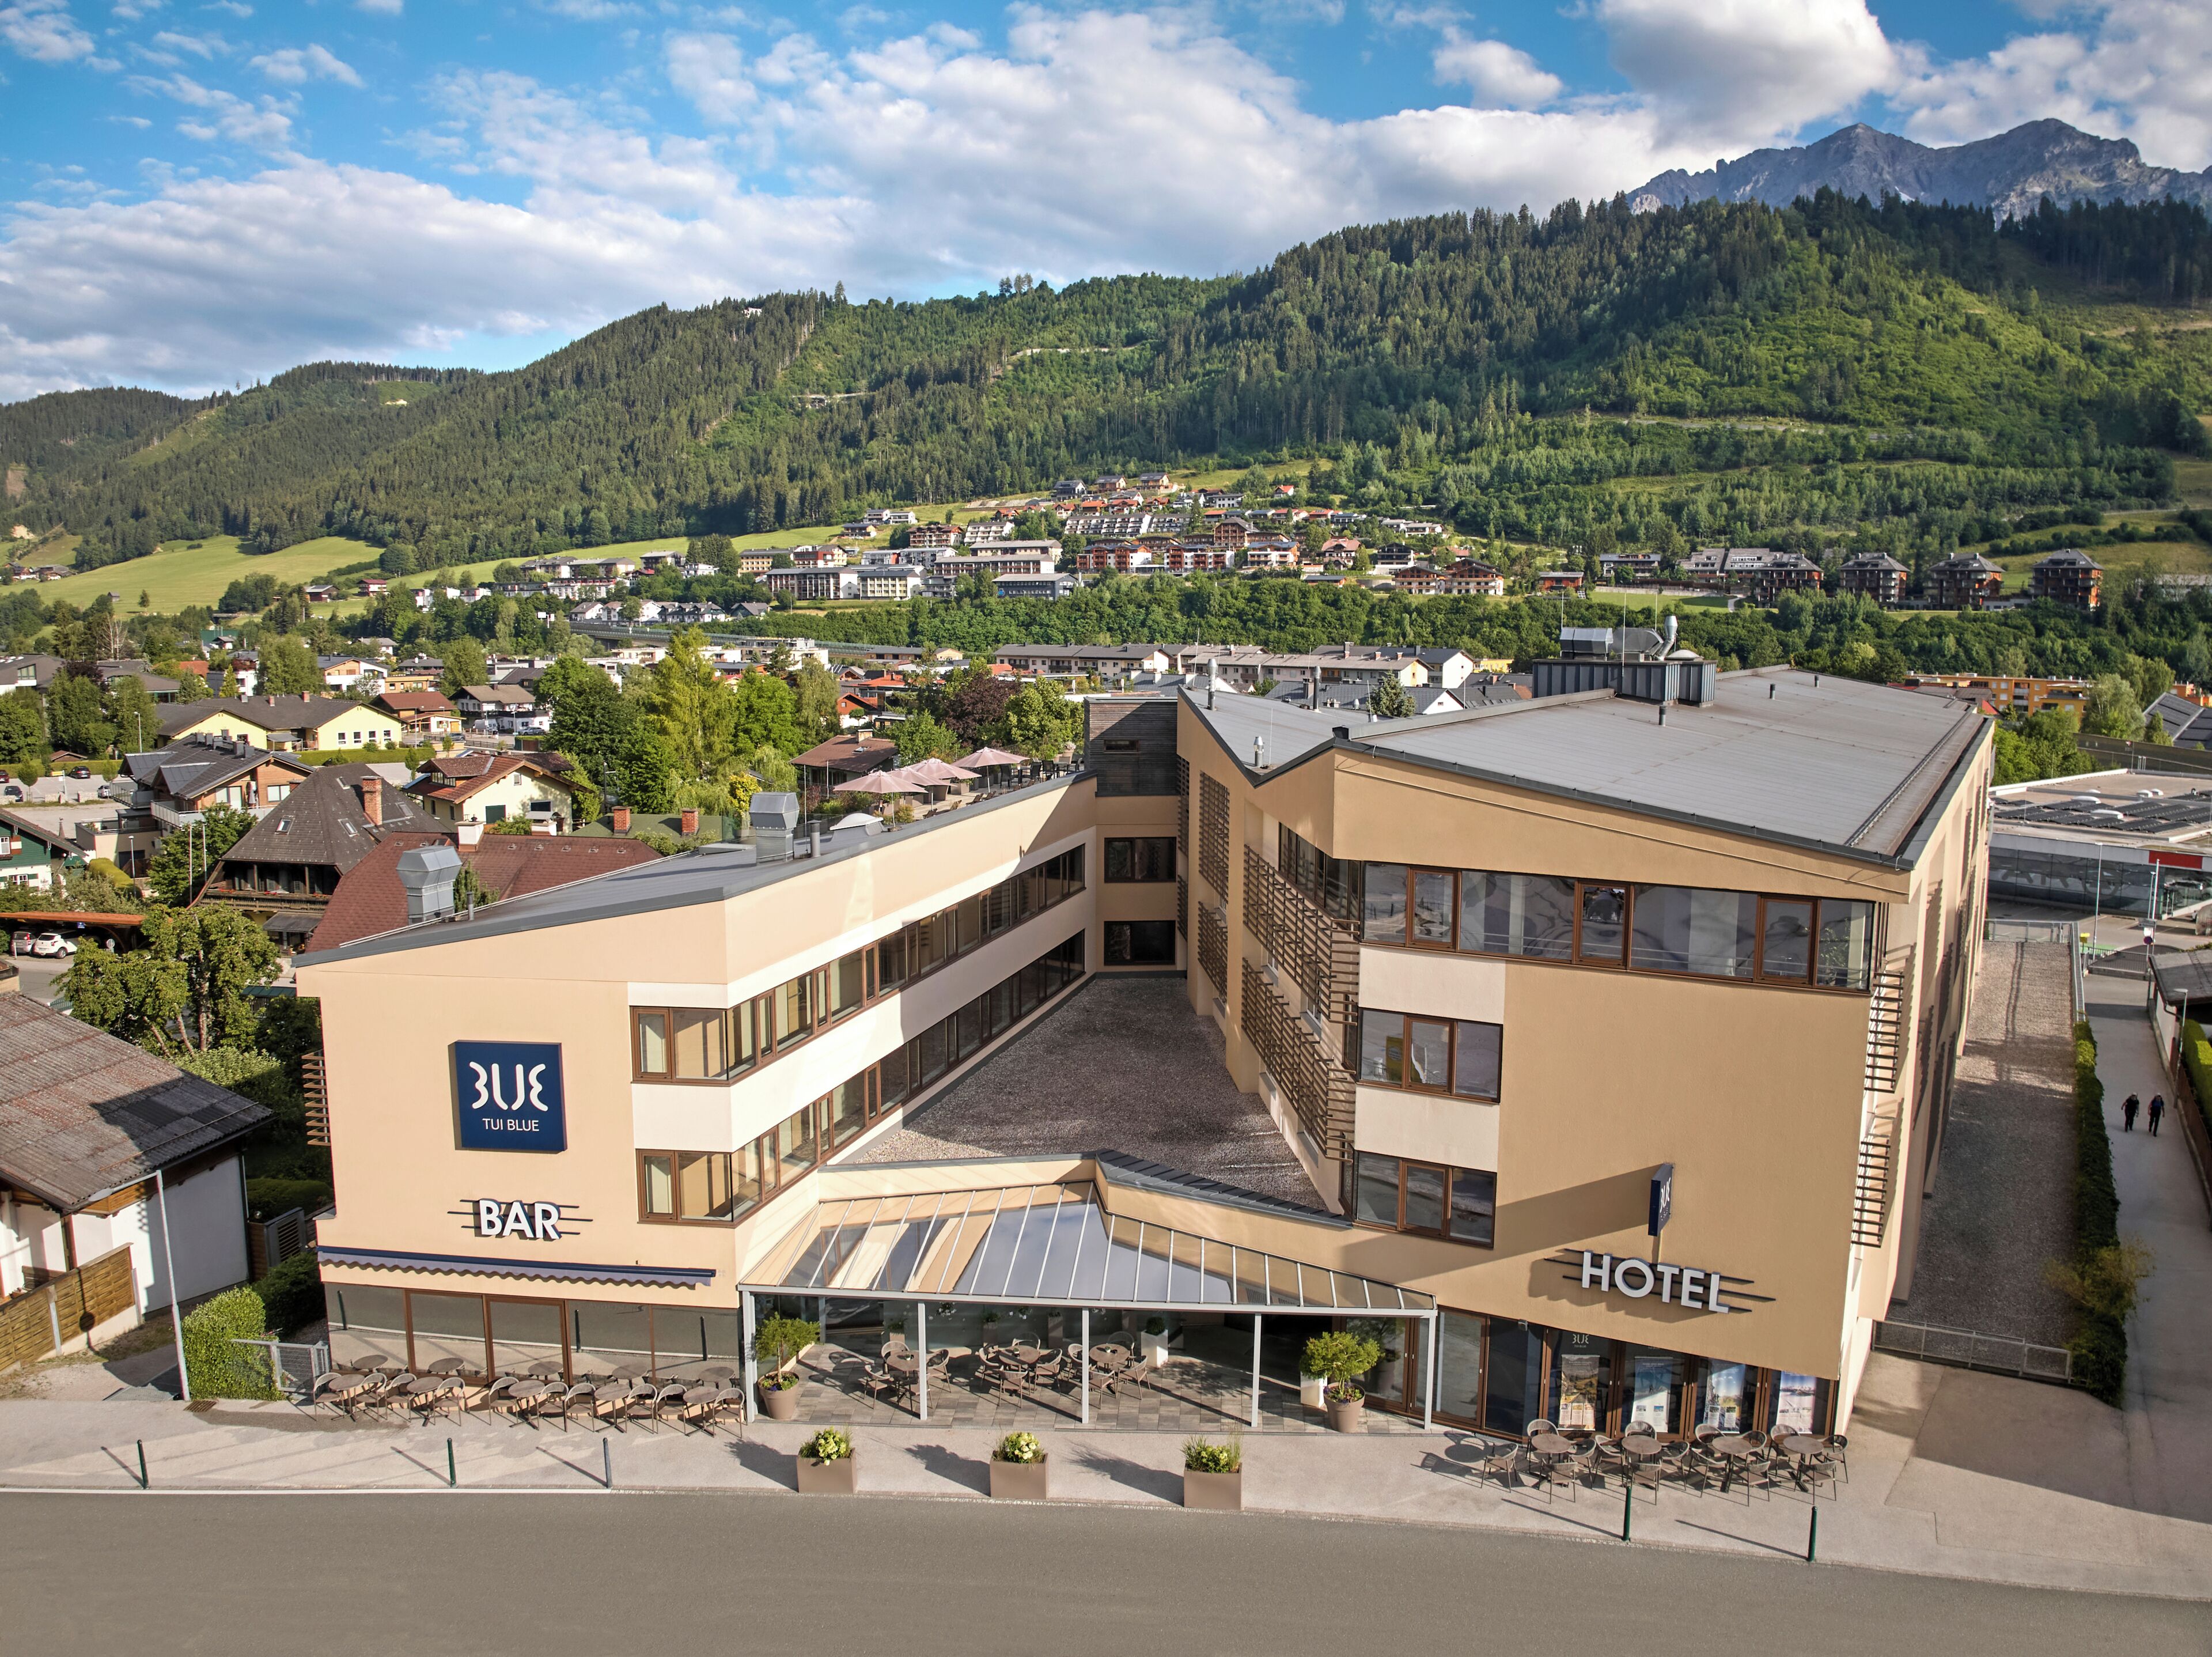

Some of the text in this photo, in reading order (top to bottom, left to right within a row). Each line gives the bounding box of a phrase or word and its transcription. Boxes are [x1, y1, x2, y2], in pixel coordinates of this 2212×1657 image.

[482, 1118, 540, 1132] TUI BLUE
[479, 1198, 562, 1239] BAR
[1582, 1250, 1730, 1314] HOTEL
